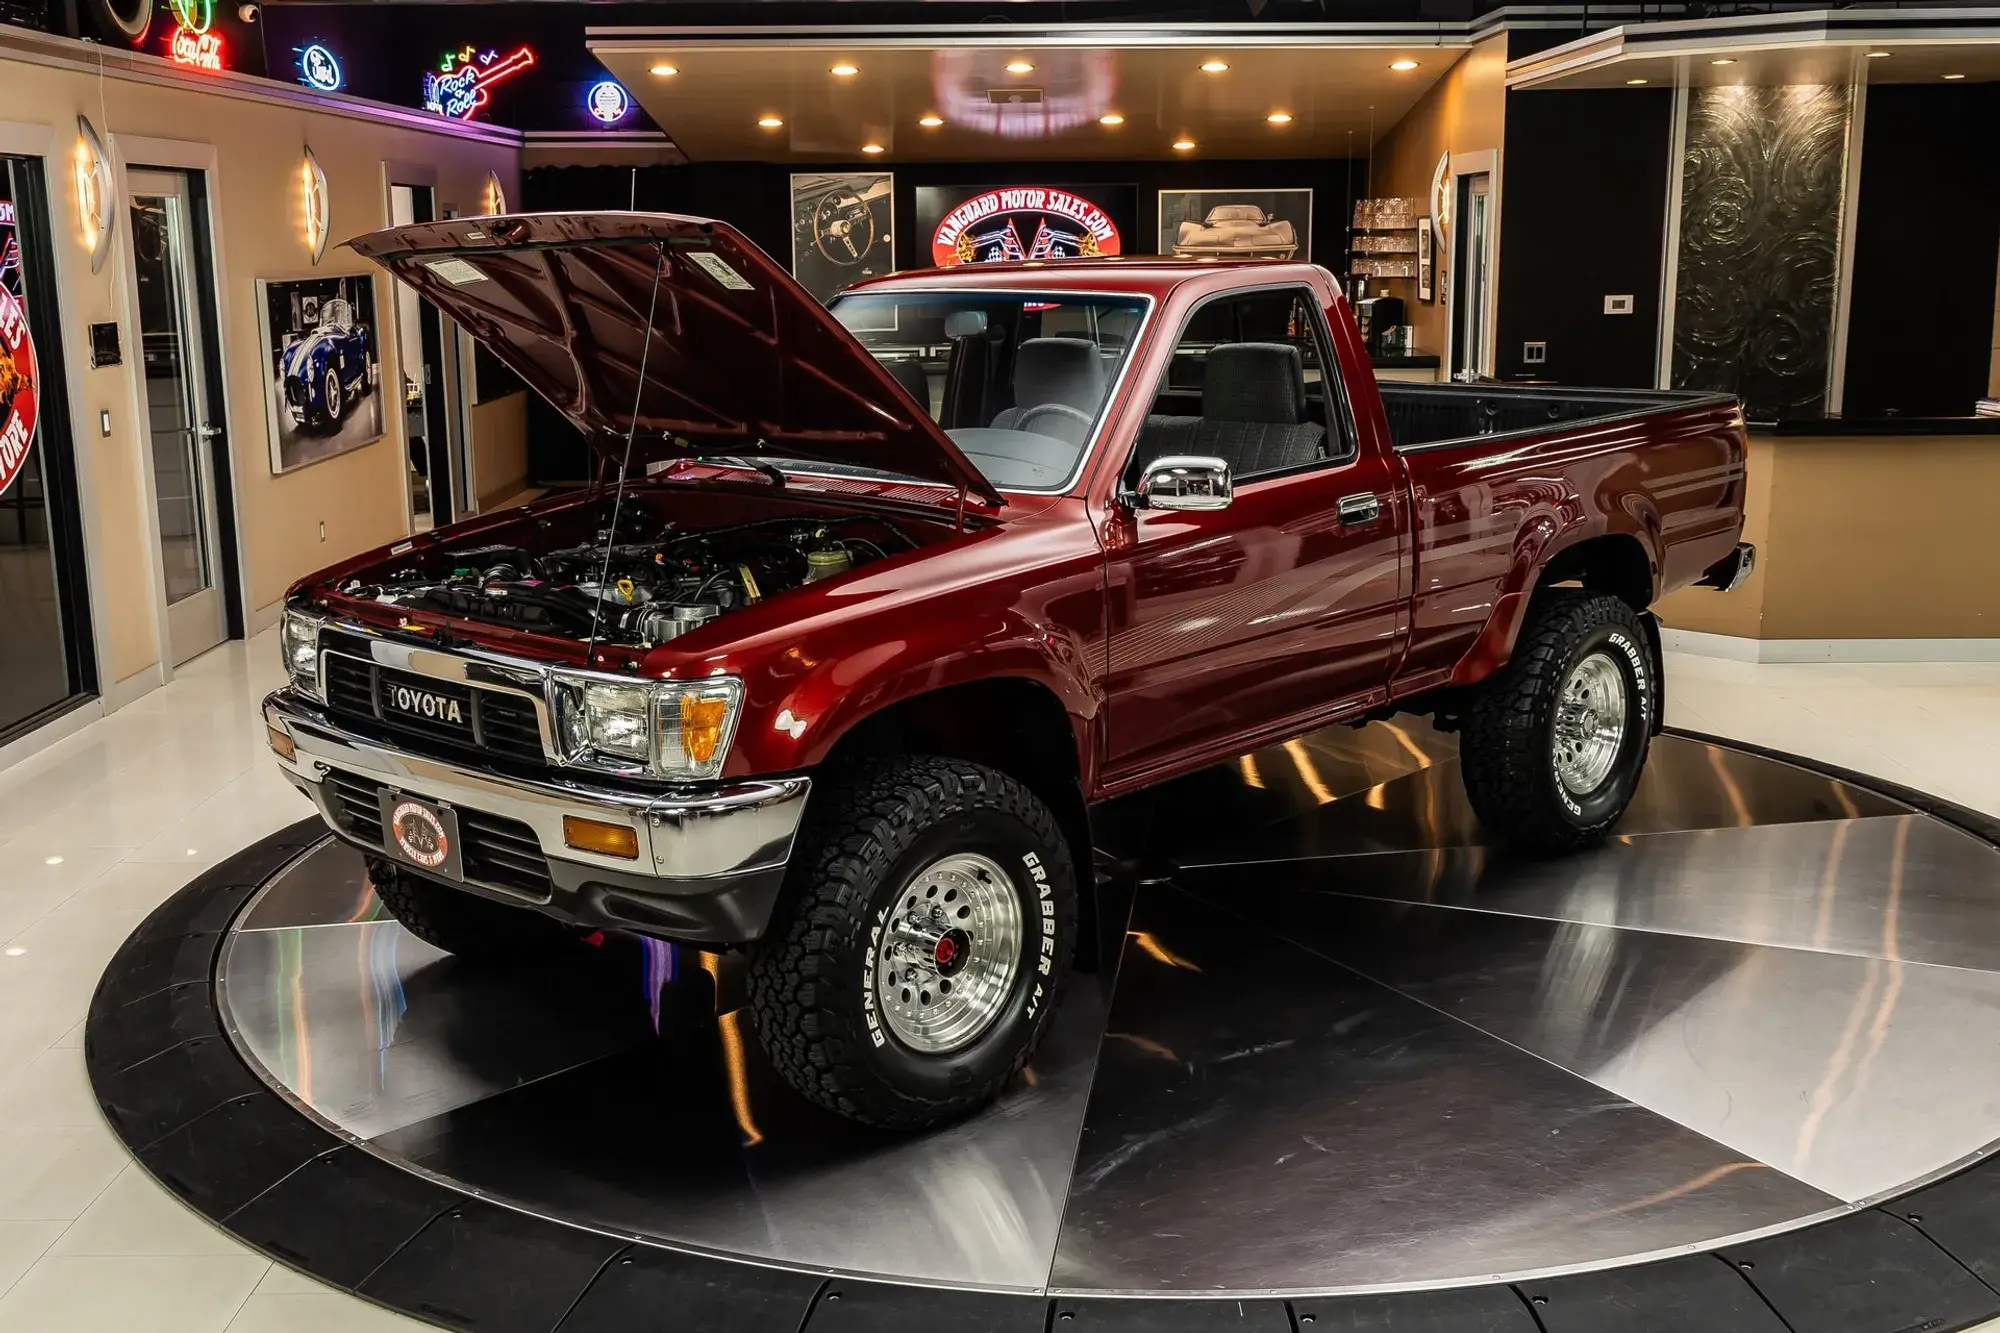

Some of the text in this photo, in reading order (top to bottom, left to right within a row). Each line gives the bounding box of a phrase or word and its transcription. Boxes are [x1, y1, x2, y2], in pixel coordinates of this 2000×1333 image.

[440, 68, 476, 96] Rock
[447, 88, 477, 117] Roll
[937, 190, 1115, 246] VANGUARD MOTOR SALES.COM
[387, 684, 463, 723] TOYOTA
[1608, 633, 1648, 721] GRABBER A/T
[1022, 851, 1056, 1020] GRABBER A/T
[863, 906, 889, 1048] GENERAL
